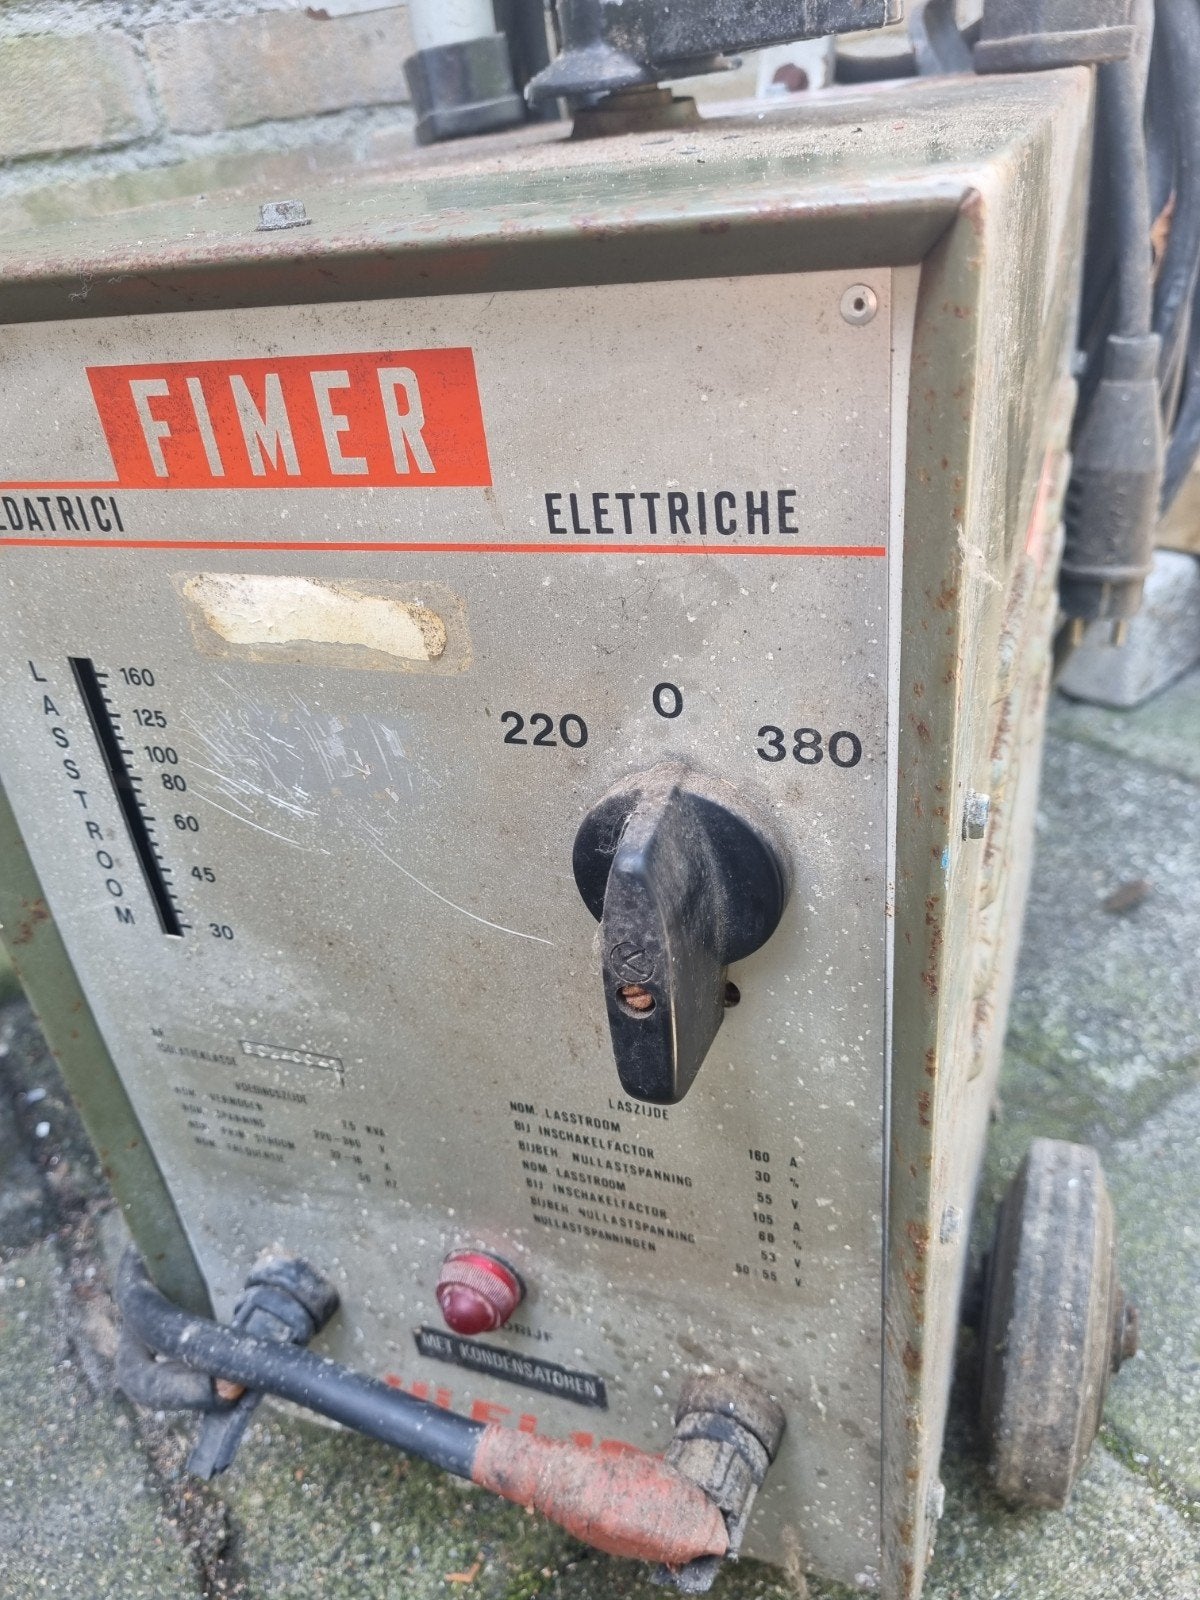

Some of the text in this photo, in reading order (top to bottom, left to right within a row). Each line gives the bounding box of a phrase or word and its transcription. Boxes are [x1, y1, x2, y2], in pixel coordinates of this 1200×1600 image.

[129, 367, 436, 478] FIMER
[545, 489, 799, 535] ELETTRICHE
[120, 668, 155, 686] 160
[652, 682, 684, 718] 0
[133, 709, 167, 728] 125
[501, 711, 589, 748] 220
[144, 746, 178, 764] 100
[756, 725, 862, 768] 380
[162, 773, 187, 792] 80
[174, 814, 199, 832] 60
[191, 866, 216, 883] 45
[209, 923, 234, 940] 30
[609, 1098, 669, 1120] LASZIJDE
[545, 1108, 621, 1133] LASSTROOM
[514, 1120, 655, 1158] BIJ INSCHAKELFACTOR
[749, 1149, 770, 1163] 160
[556, 1167, 626, 1191] LASSTROOM
[572, 1152, 693, 1187] NULLASTSPANNING
[755, 1170, 770, 1183] 30
[526, 1177, 667, 1219] BIJ INSCHAKELFACTOR
[757, 1192, 798, 1209] 55 V
[578, 1207, 695, 1244] NULLASTSPANNING
[753, 1212, 800, 1232] 105 A
[761, 1250, 801, 1268] 53 V
[422, 1333, 598, 1398] MET KONDENSATOREN
